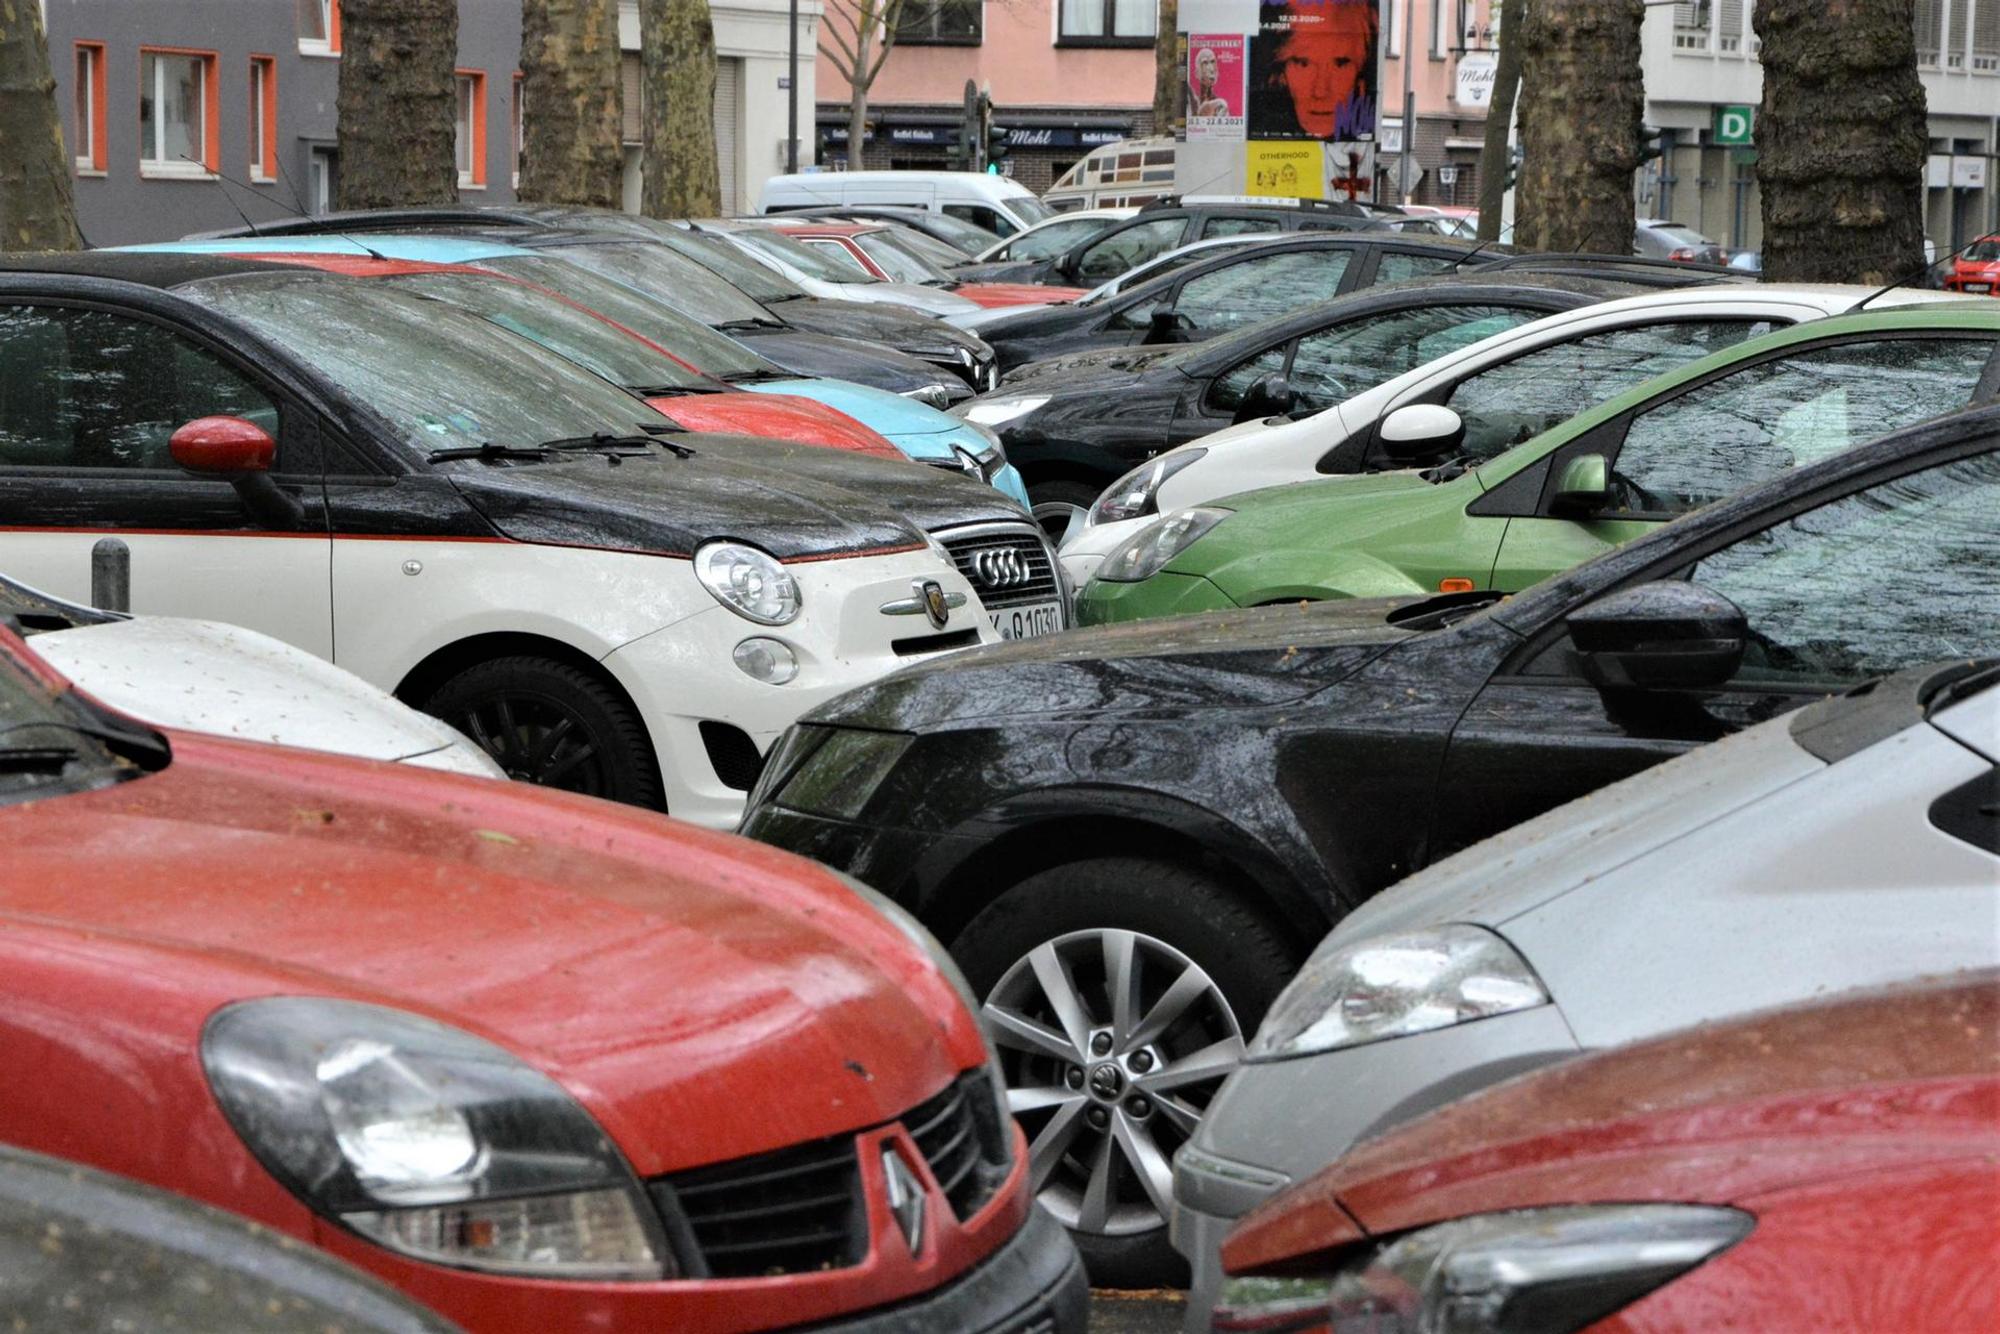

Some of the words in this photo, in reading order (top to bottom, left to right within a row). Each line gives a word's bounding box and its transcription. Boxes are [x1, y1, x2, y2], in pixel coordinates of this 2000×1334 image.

[1459, 69, 1496, 82] Mehl
[1722, 113, 1746, 138] D
[1010, 130, 1052, 145] Mehl
[1260, 151, 1310, 160] OTHERHOOD
